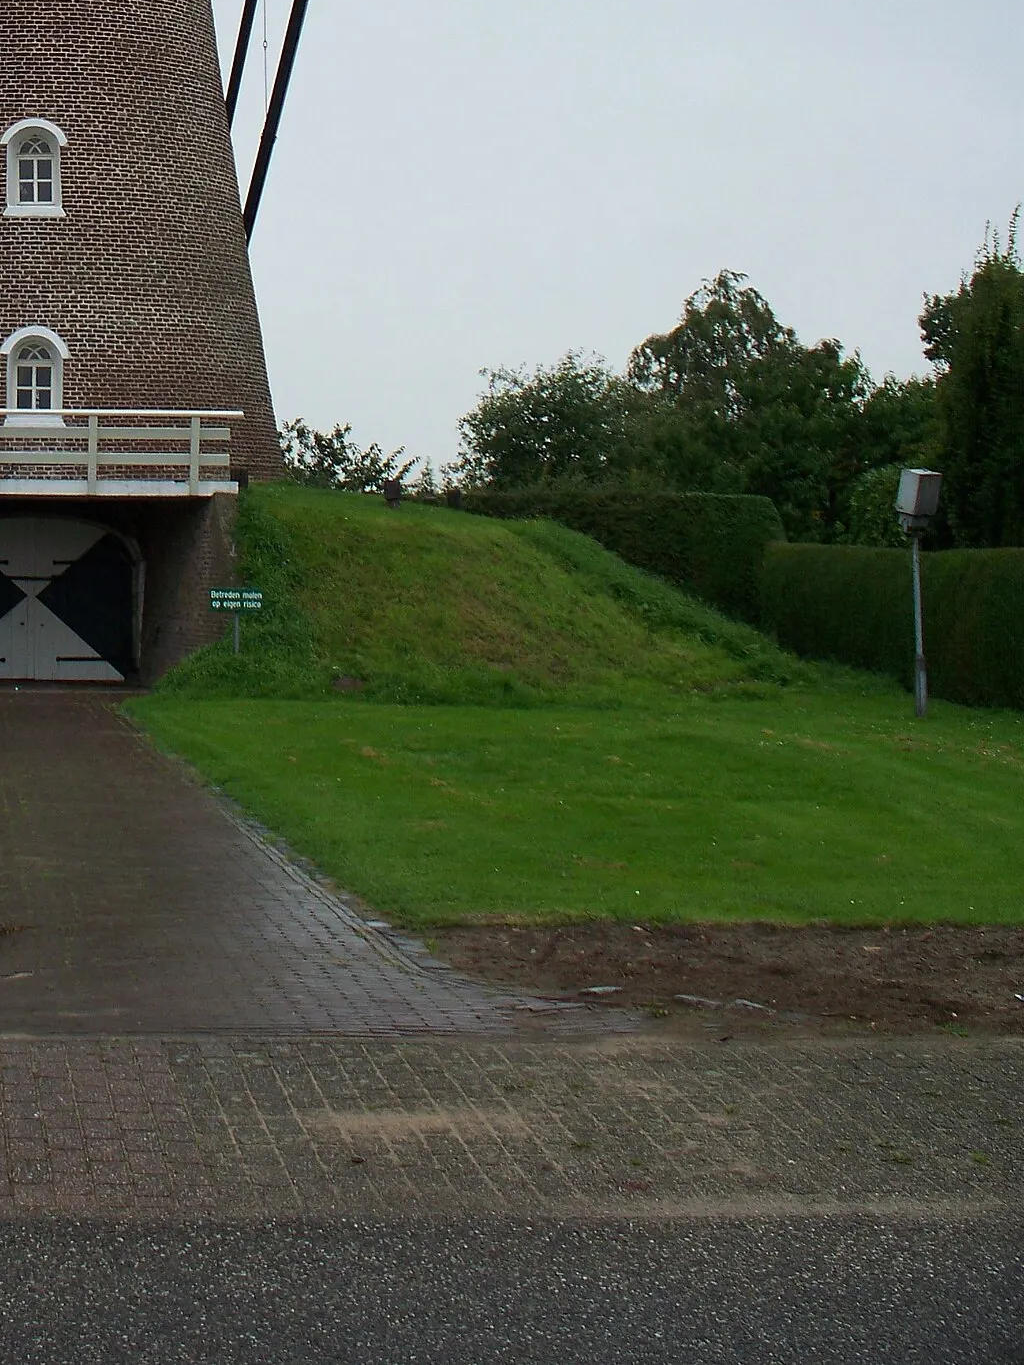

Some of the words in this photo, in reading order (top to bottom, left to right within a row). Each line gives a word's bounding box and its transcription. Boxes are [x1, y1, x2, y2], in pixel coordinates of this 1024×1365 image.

[210, 590, 240, 599] Betreden
[242, 591, 263, 599] molen
[212, 601, 221, 609] op
[223, 600, 241, 609] eigen
[243, 600, 262, 608] risico
